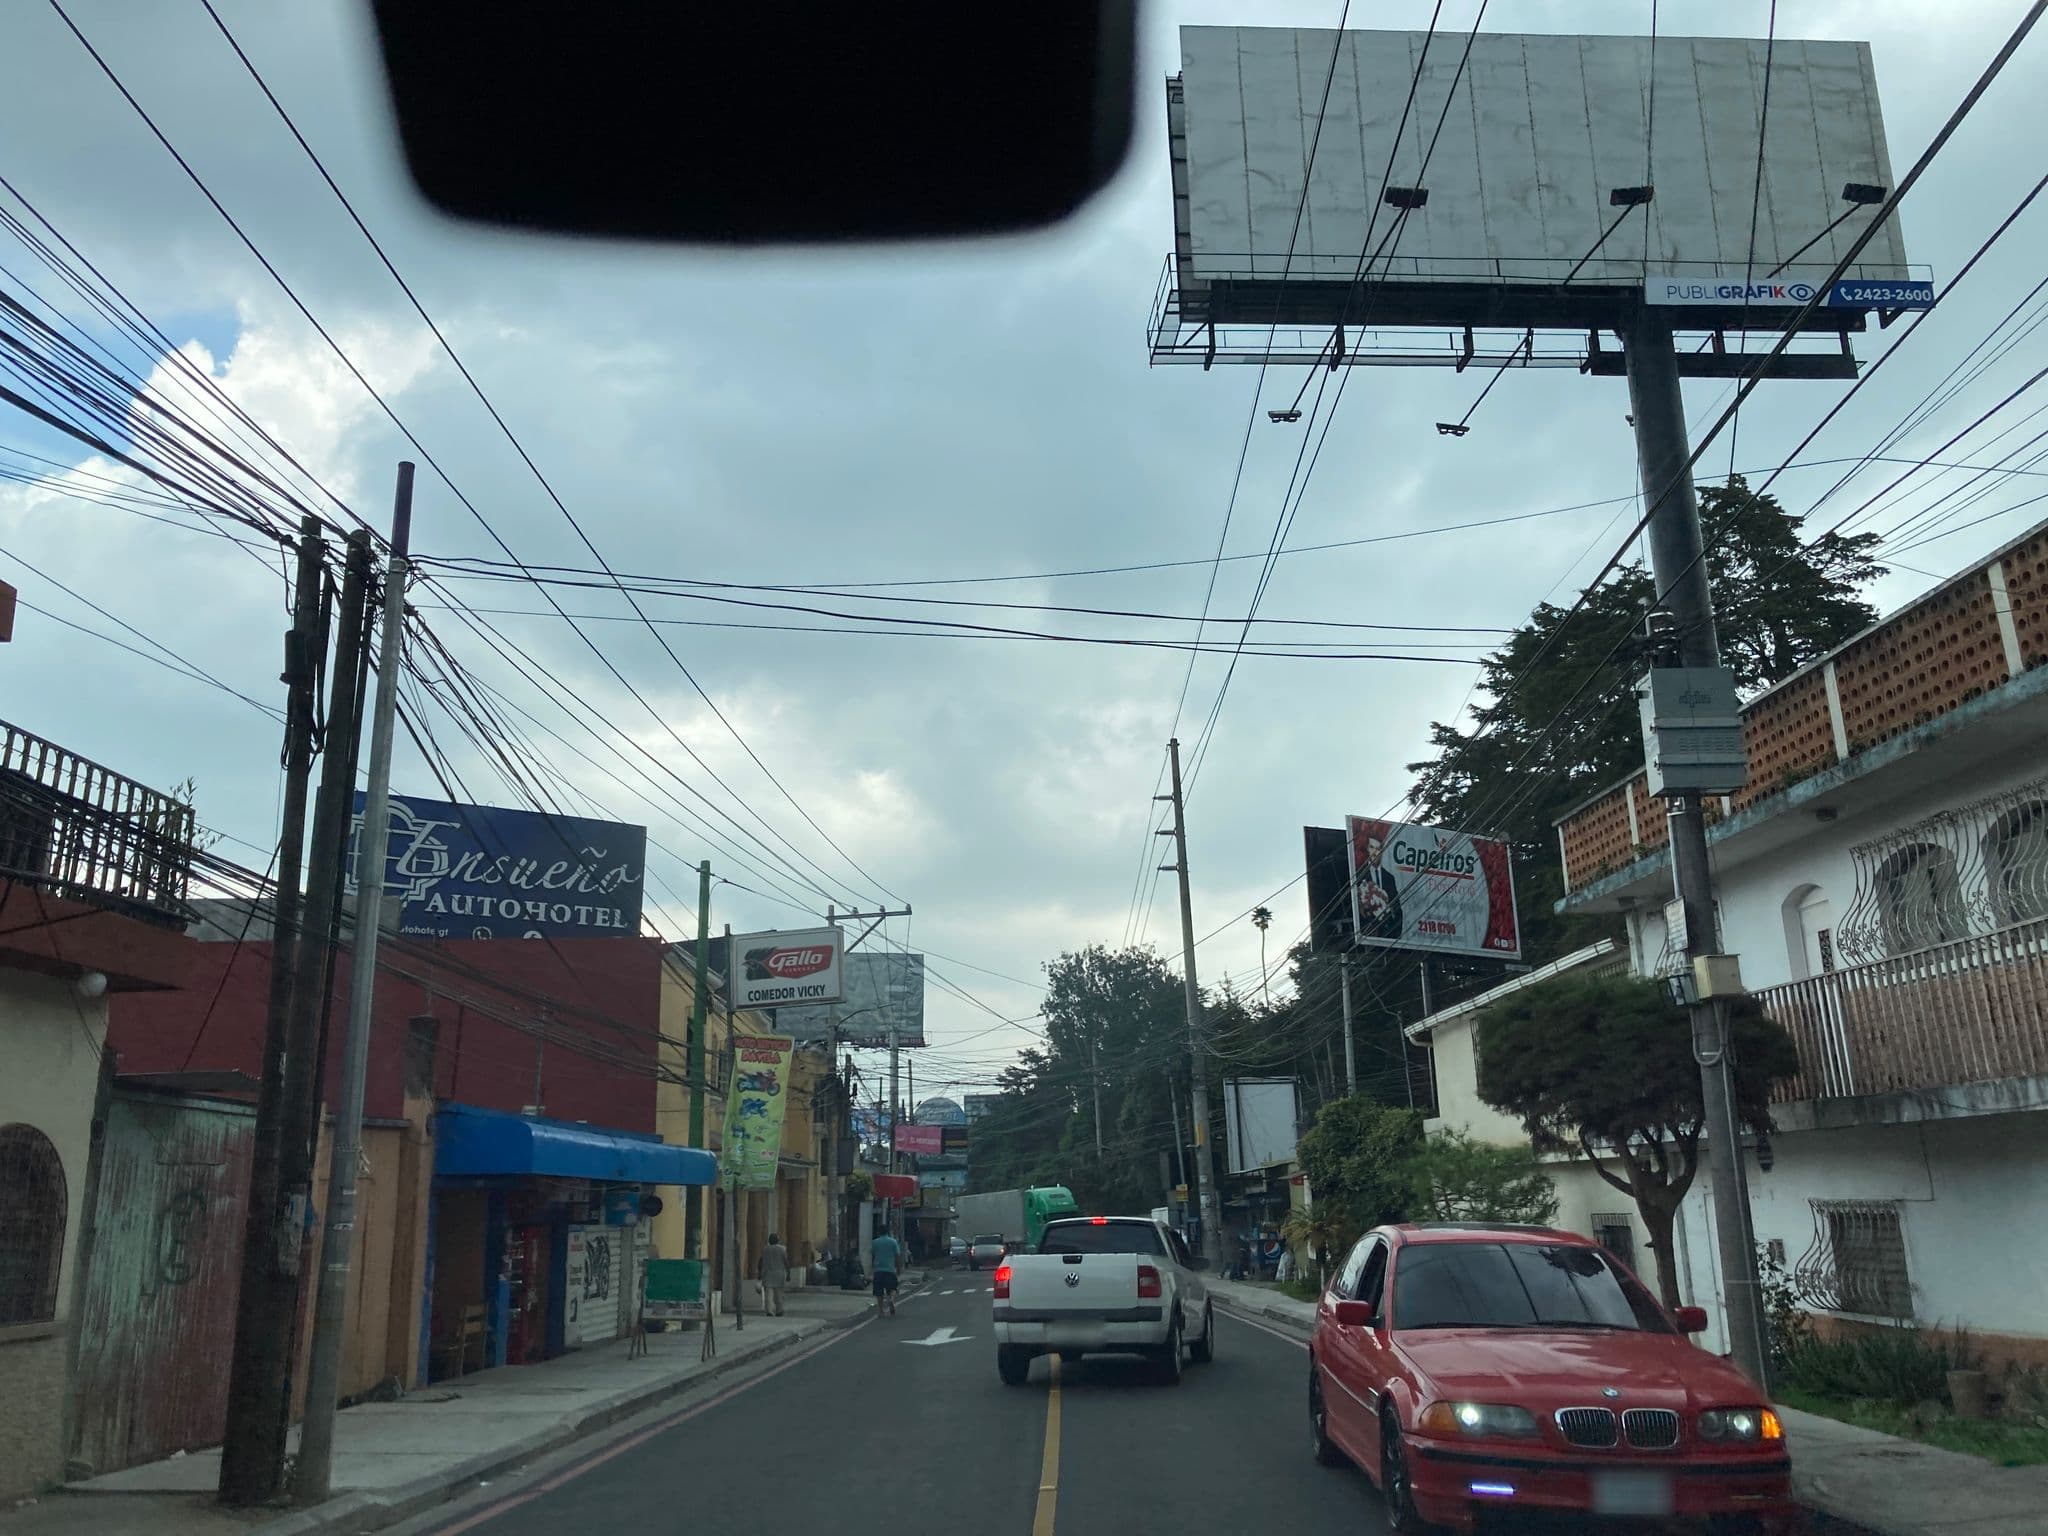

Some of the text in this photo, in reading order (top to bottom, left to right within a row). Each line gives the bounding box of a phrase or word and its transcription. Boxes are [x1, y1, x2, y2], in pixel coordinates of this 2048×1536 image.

[1666, 284, 1932, 302] PUBLIGRAFIK 2423-2600
[397, 820, 641, 895] Ensueño
[1393, 840, 1475, 873] Capeiros
[425, 892, 629, 928] AUTOHOTEL
[769, 950, 823, 972] Gallo
[748, 984, 826, 1002] COMEDOR VICKY
